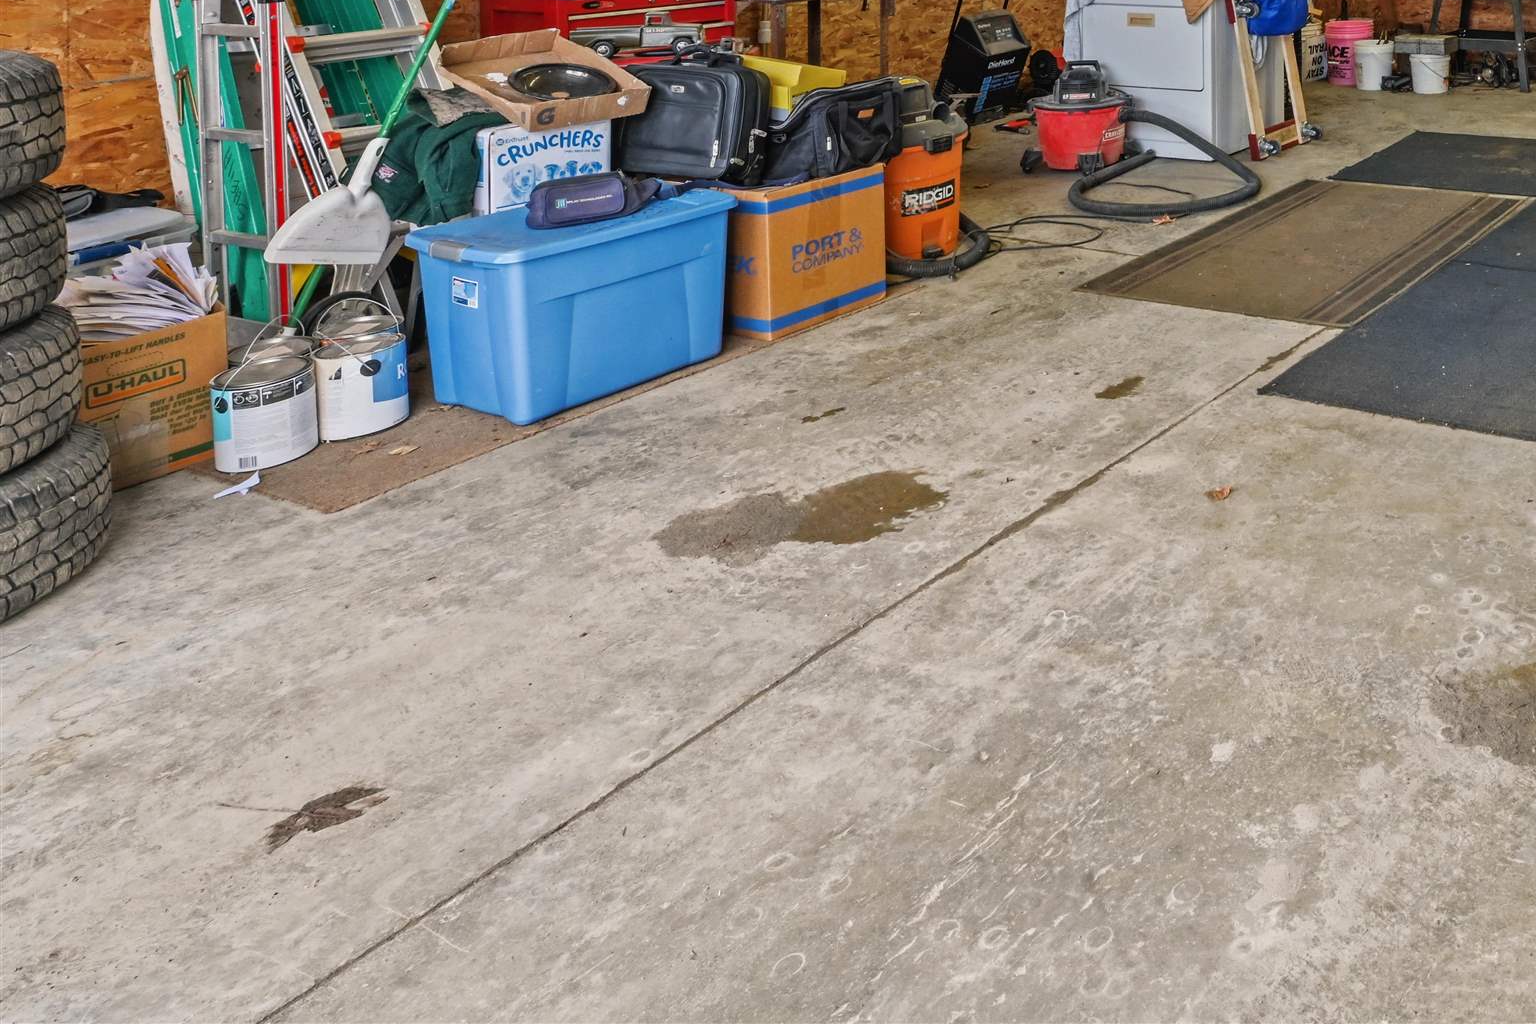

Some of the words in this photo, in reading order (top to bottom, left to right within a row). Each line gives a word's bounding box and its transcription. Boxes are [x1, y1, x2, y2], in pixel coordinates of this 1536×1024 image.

[988, 56, 1016, 70] DieHard
[1305, 66, 1325, 81] STAY
[1311, 55, 1323, 67] ON
[497, 129, 604, 166] CRUNCHERS
[904, 183, 954, 208] RIDGID
[791, 230, 846, 261] PORT
[849, 227, 863, 243] &
[791, 242, 863, 274] COMPANY
[145, 331, 186, 350] HANDLES
[92, 364, 181, 398] U-HAUL
